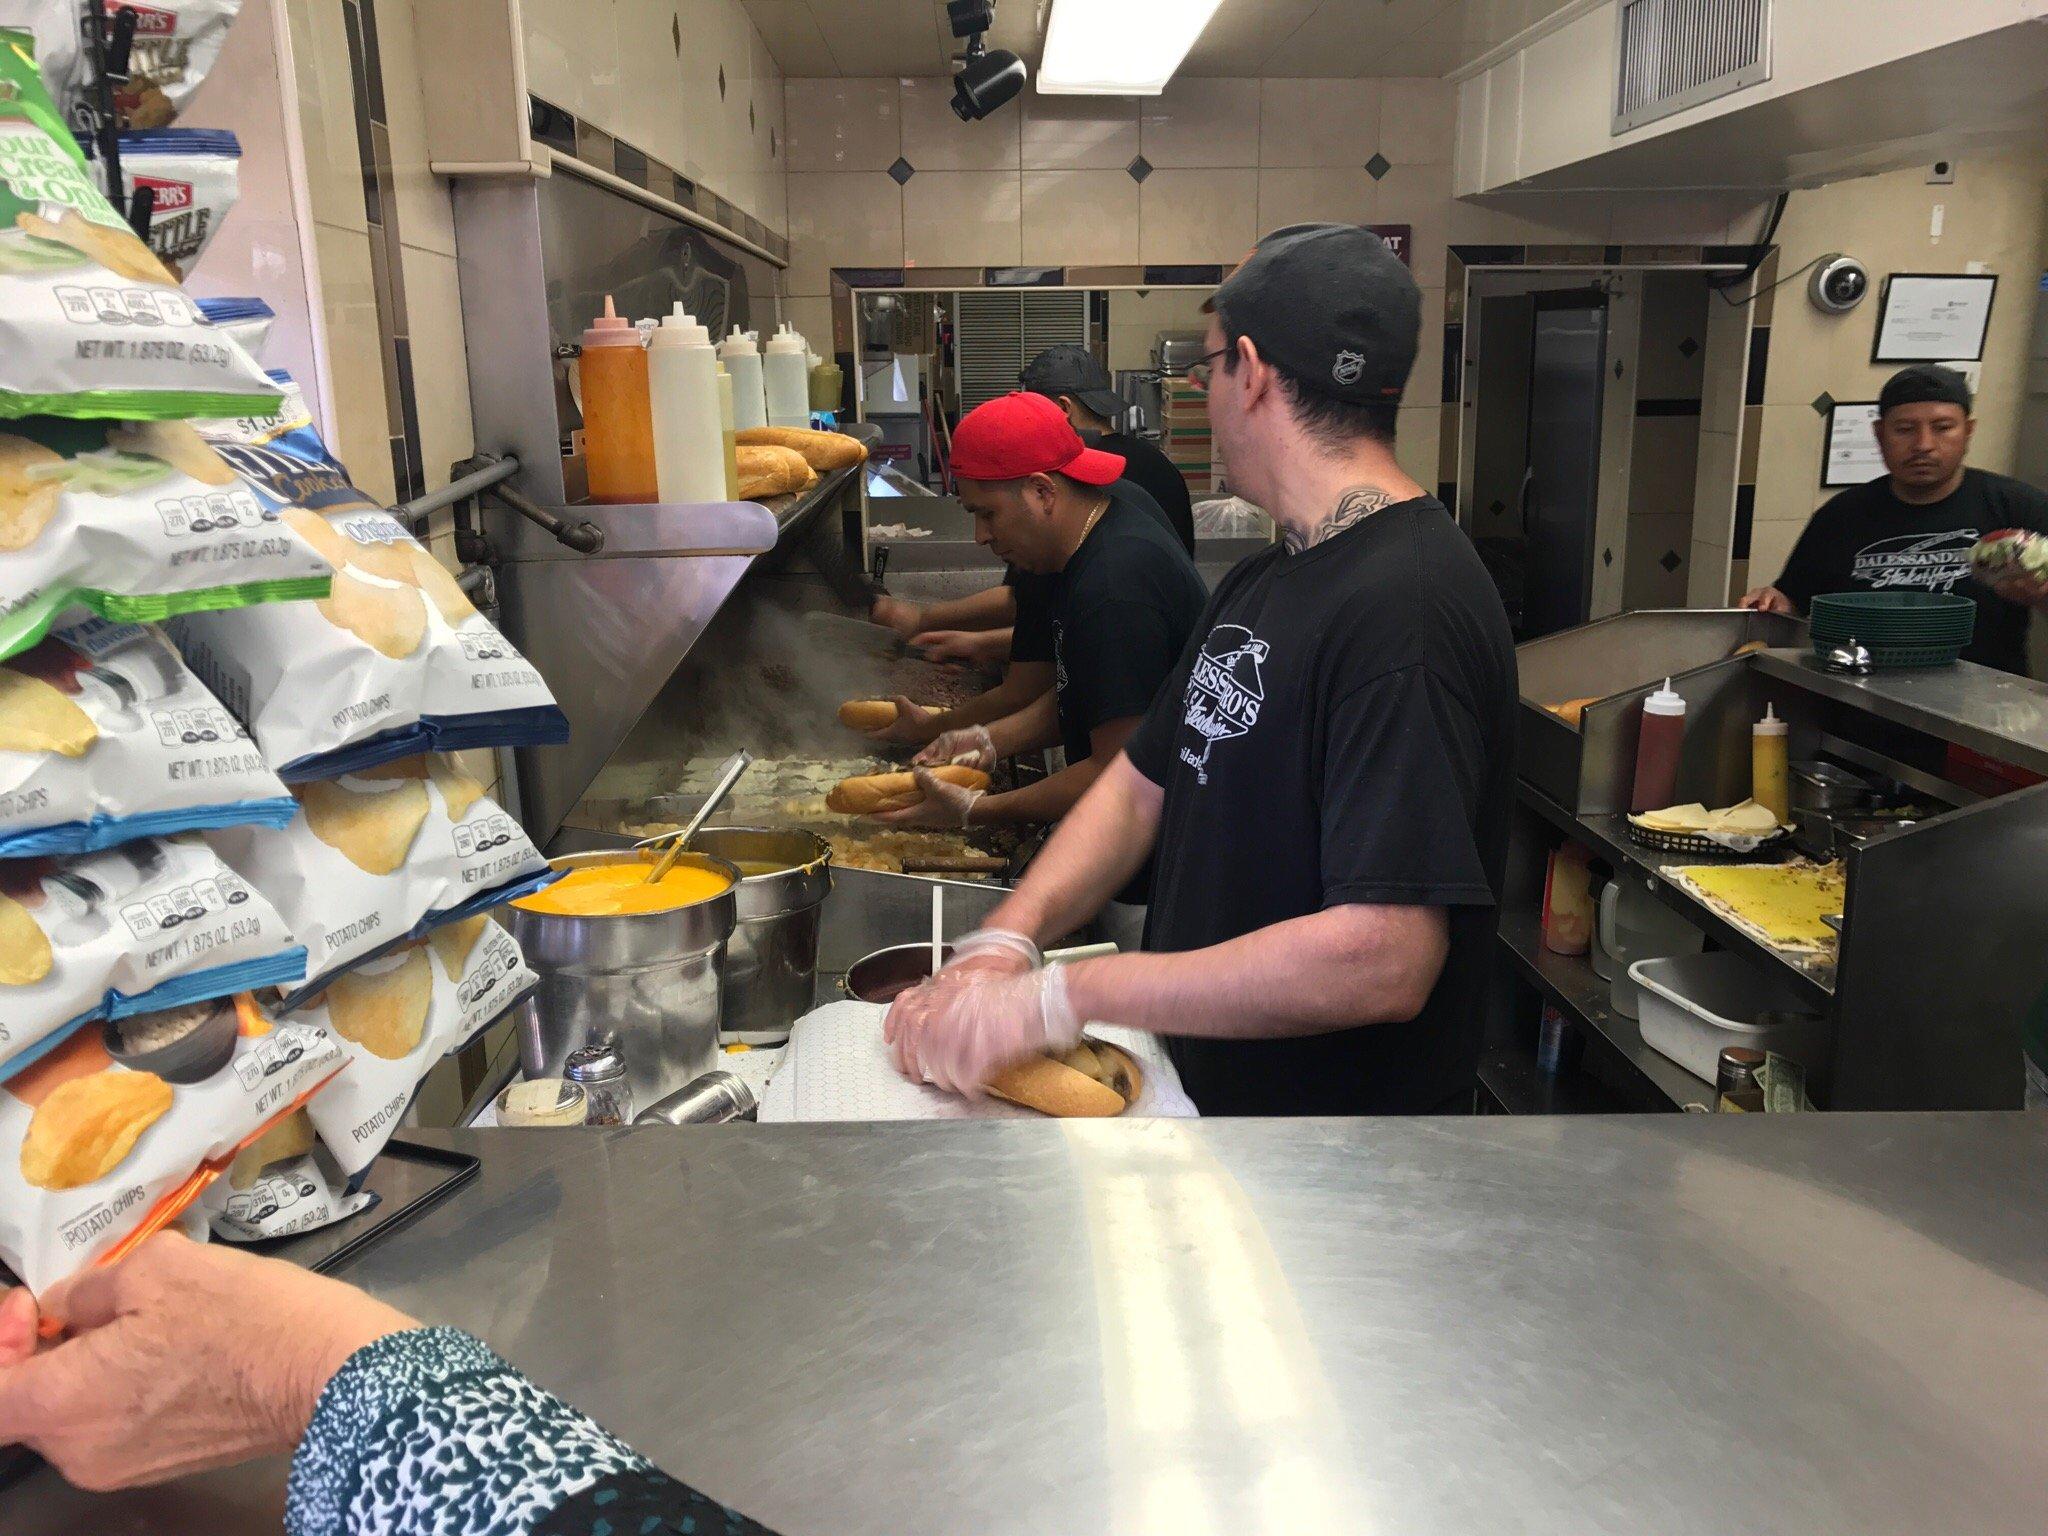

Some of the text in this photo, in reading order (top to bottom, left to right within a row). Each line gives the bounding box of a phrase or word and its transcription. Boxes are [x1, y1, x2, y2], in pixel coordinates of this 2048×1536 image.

[462, 867, 478, 884] NET
[325, 911, 381, 951] POTATO CHIPS
[254, 1093, 270, 1116] NET
[352, 1092, 406, 1144] POTATO CHIPS
[62, 1209, 114, 1251] POTATO
[112, 1184, 146, 1217] CHIPS
